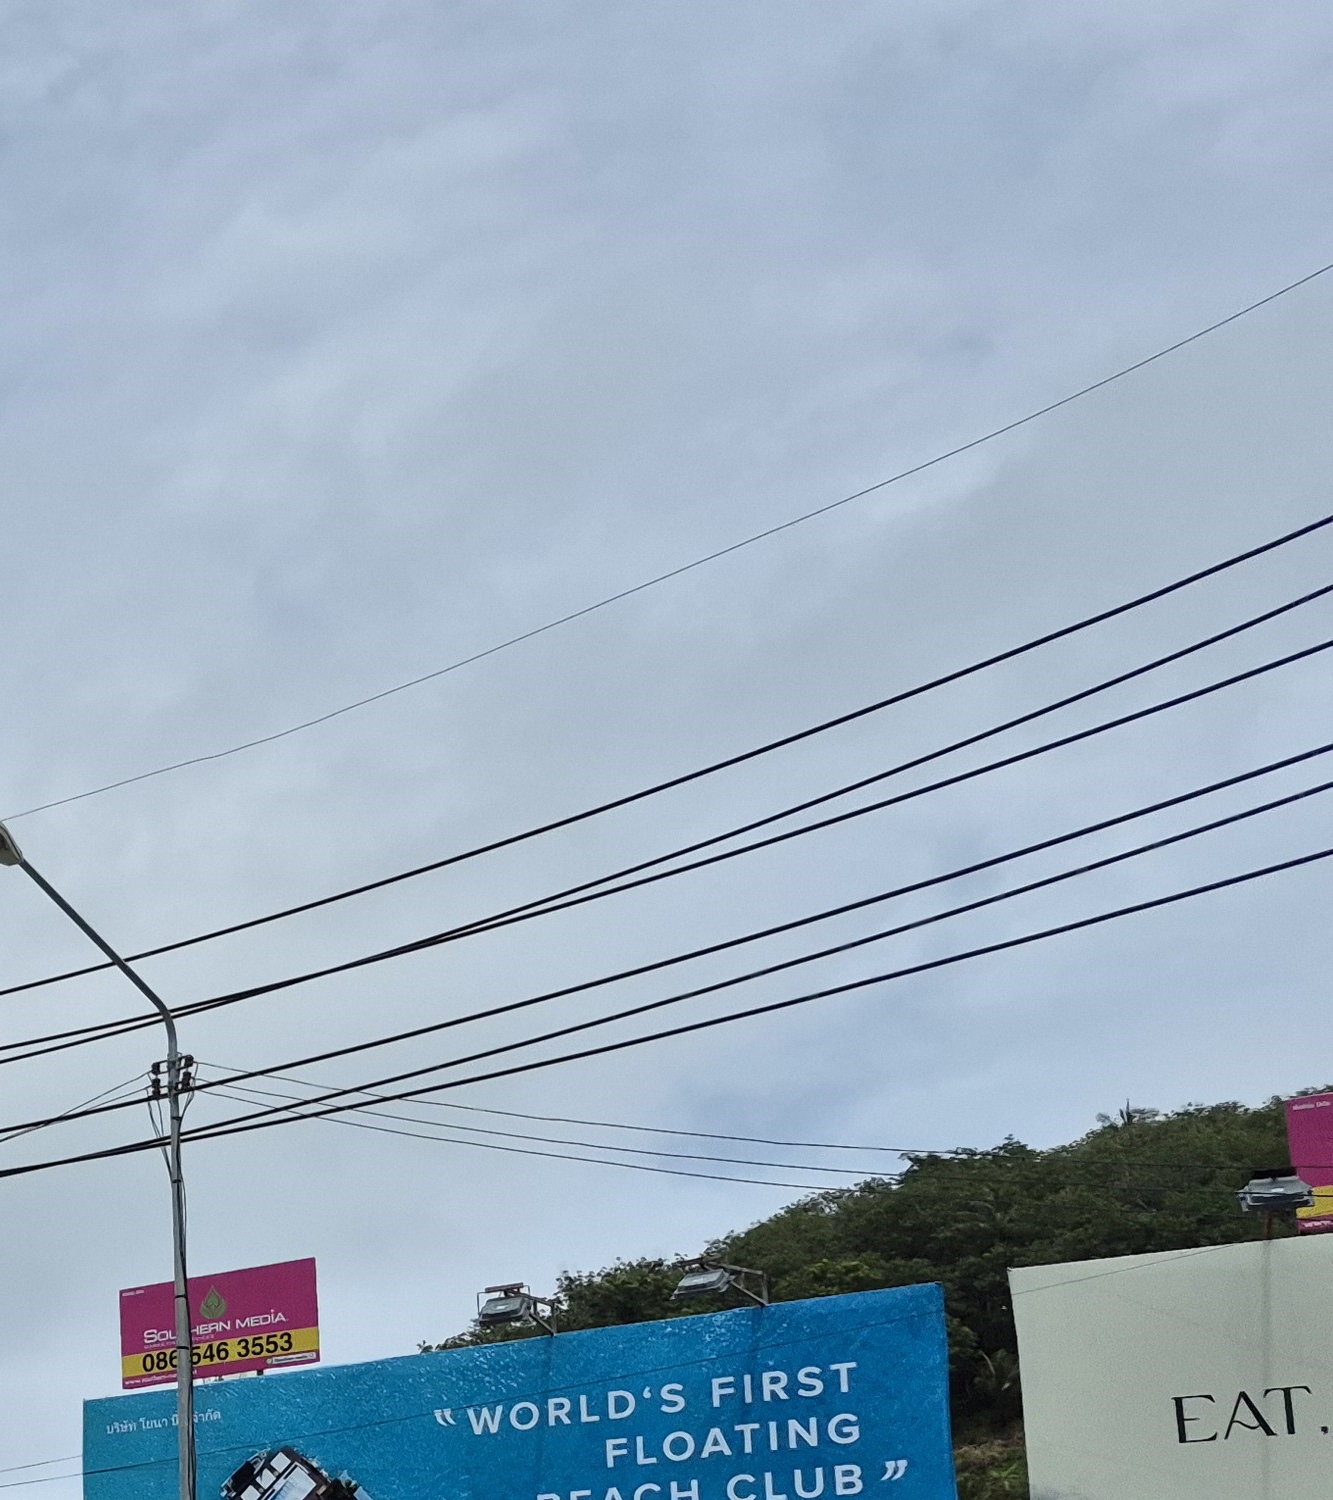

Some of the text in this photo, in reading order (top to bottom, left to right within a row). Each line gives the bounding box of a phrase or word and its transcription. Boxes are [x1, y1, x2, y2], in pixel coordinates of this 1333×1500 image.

[144, 1319, 231, 1344] SOUHERN
[236, 1332, 293, 1358] 3553
[711, 1361, 858, 1408] FIRST
[139, 1417, 168, 1431] โยนา
[1171, 1385, 1329, 1444] EAT.
[605, 1413, 861, 1468] FLOATING
